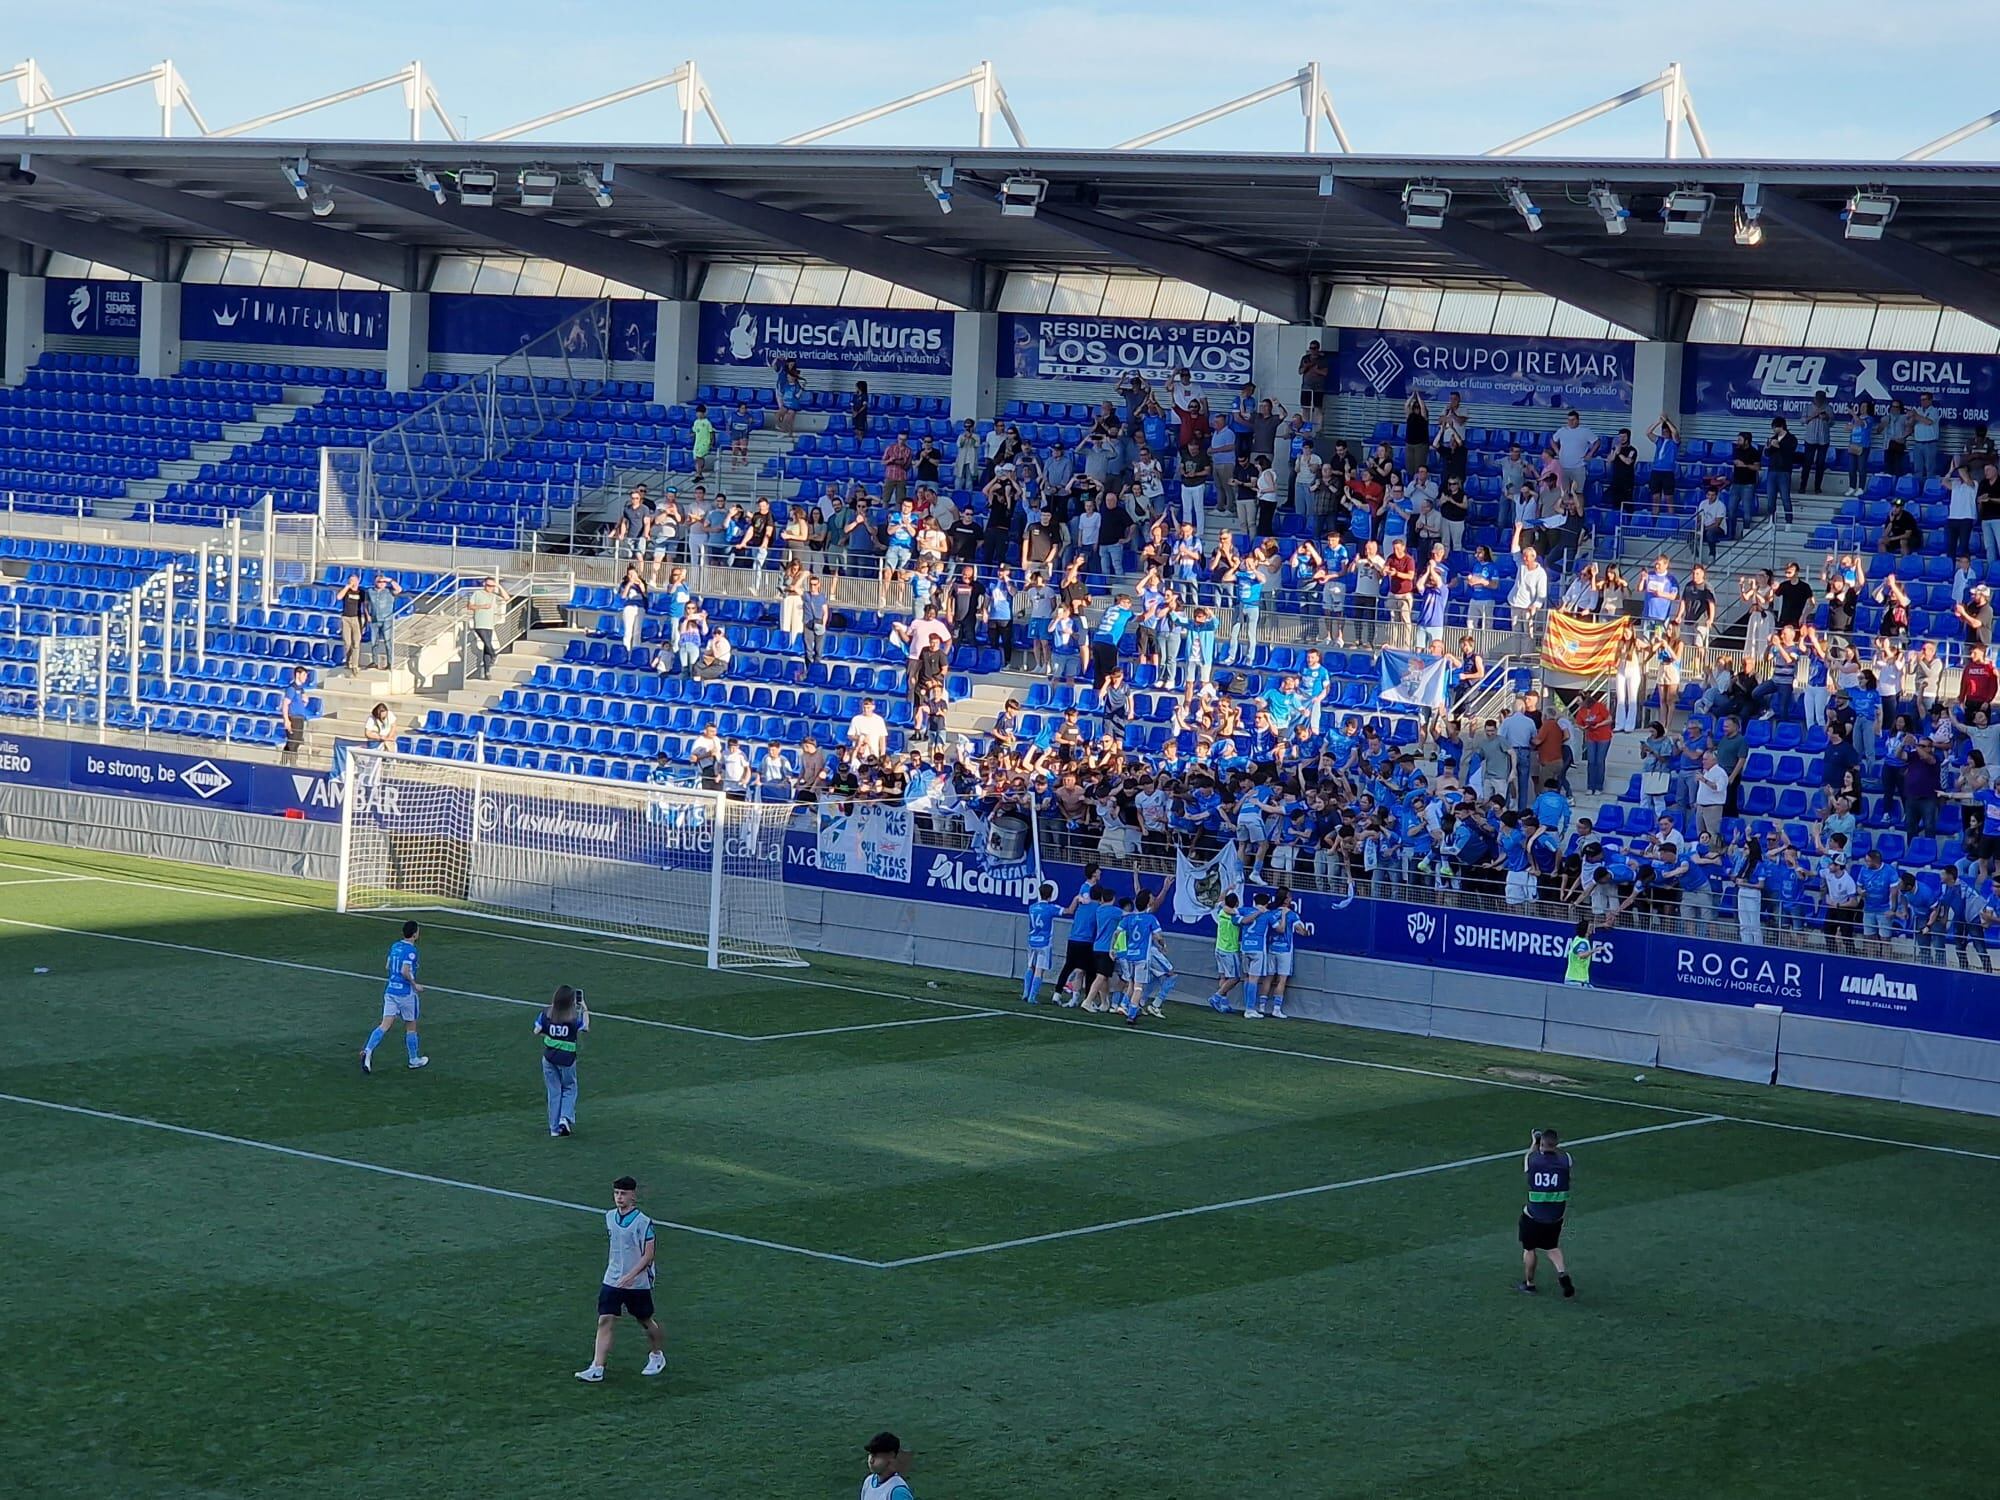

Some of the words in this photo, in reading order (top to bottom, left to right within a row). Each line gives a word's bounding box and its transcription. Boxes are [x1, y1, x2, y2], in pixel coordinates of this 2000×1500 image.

[105, 291, 130, 302] FIELES
[105, 303, 136, 314] SIEMPRE
[764, 316, 942, 350] HuescAlturas
[1040, 321, 1163, 341] RESIDENCIA
[1193, 328, 1251, 345] EDAD
[764, 347, 797, 360] Trabajos
[800, 349, 839, 360] verticales,
[1039, 339, 1107, 364] LOS
[1118, 342, 1251, 371] OLIVOS
[1413, 346, 1509, 372] GRUPO
[1517, 351, 1617, 377] IREMAR
[1048, 365, 1090, 375] TLF.
[1215, 374, 1241, 383] 32
[1891, 360, 1971, 385] GIRAL
[1469, 378, 1492, 389] futuro
[1536, 384, 1551, 392] con
[1553, 385, 1563, 393] un
[1565, 384, 1591, 396] Grupo
[1731, 398, 1777, 411] HORMIGONES
[1962, 409, 1989, 421] OBRAS
[87, 756, 105, 773] be
[108, 760, 154, 783] strong,
[158, 763, 176, 782] be
[189, 771, 222, 787] KUHN
[503, 803, 620, 842] Casademont
[666, 829, 752, 858] Hueca
[1677, 949, 1801, 987] ROGAR
[1676, 973, 1722, 988] VENDING
[1730, 980, 1773, 995] HORECA
[1780, 986, 1802, 998] OCS
[1840, 973, 1918, 1001] LAVAZZA
[549, 1024, 569, 1037] 030
[1534, 1172, 1559, 1187] 034
